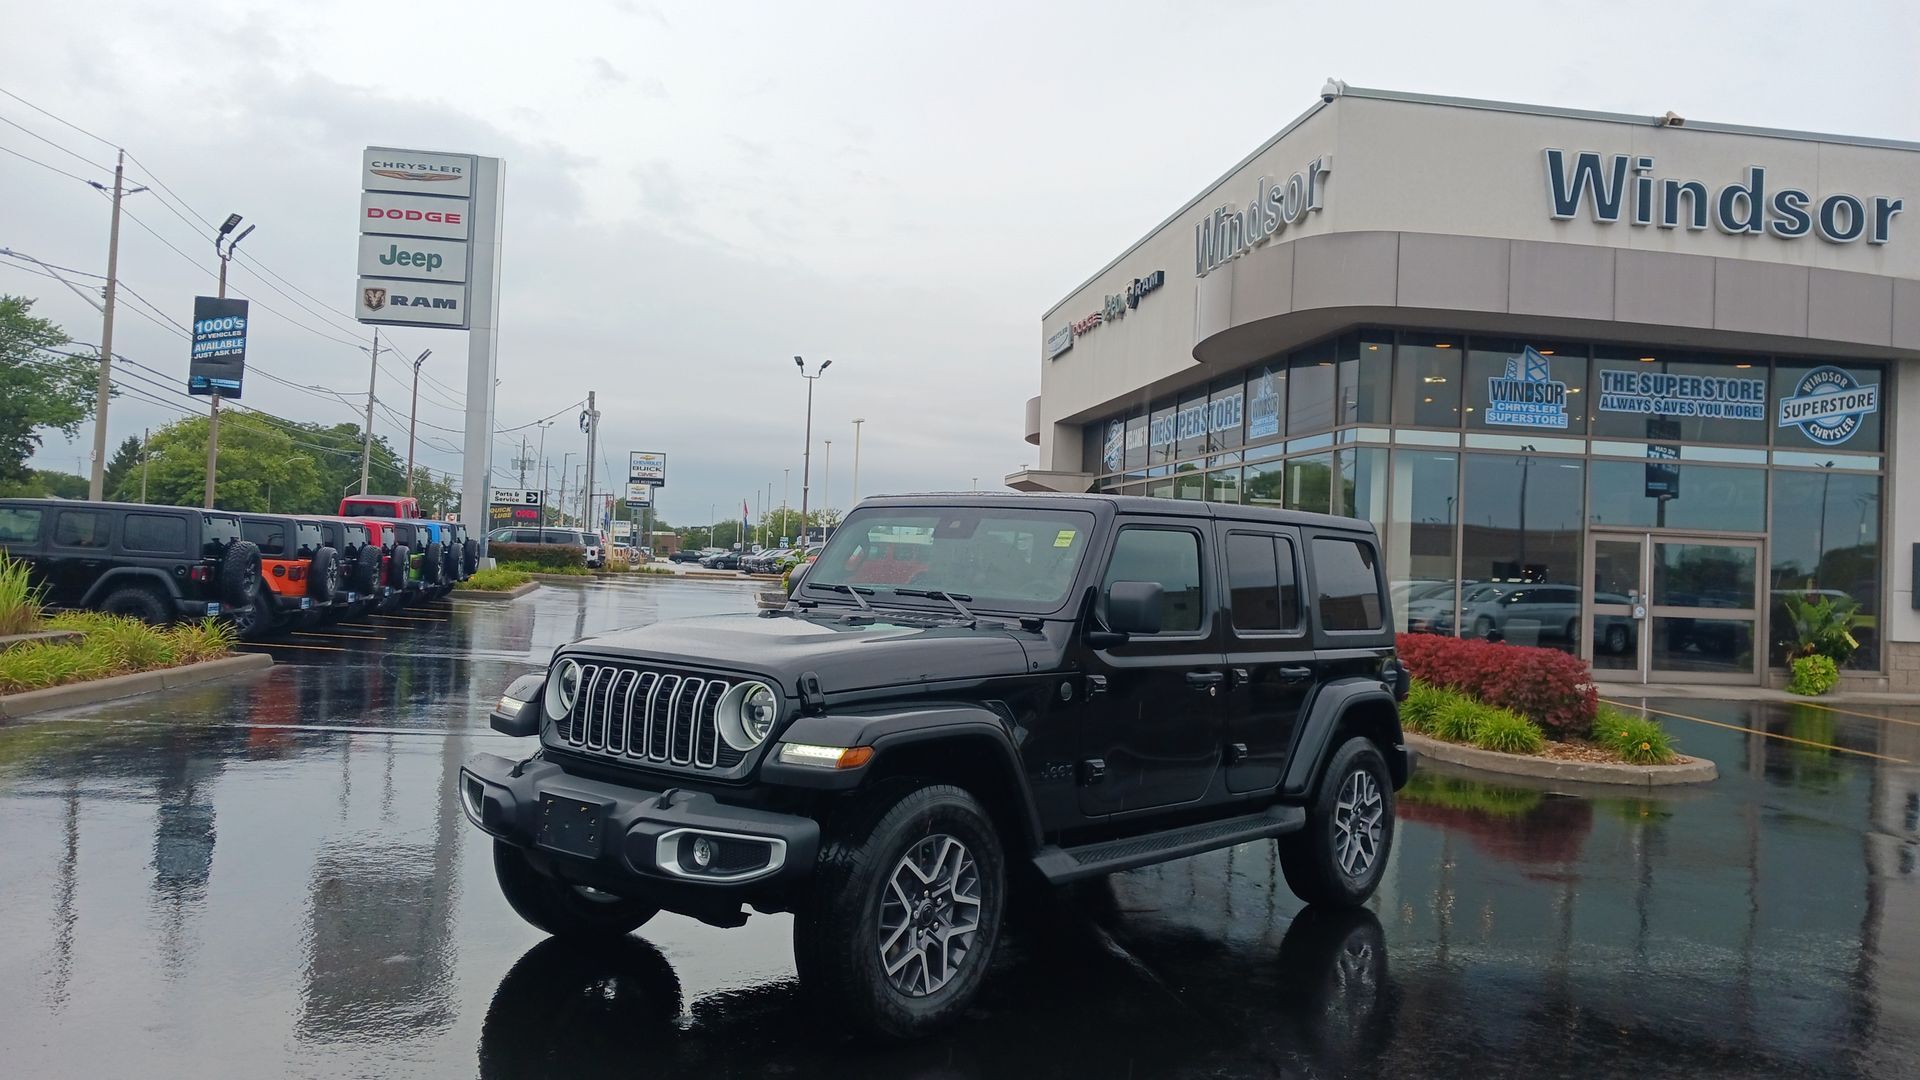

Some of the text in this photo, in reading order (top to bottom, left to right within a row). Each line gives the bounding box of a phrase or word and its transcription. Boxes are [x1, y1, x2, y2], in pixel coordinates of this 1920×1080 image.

[371, 160, 462, 174] CHRYSLER
[1545, 147, 1905, 246] Windsor
[367, 207, 461, 225] DODGE
[1195, 155, 1332, 278] Windsor
[379, 244, 443, 272] Jeep
[1135, 270, 1165, 298] RAM
[390, 295, 457, 310] RAM
[195, 316, 245, 333] 1000's
[208, 329, 242, 339] VEHICLES
[193, 347, 243, 360] JUST ASK US
[194, 339, 244, 353] AVAILABLE
[1601, 371, 1765, 402] THE SUPERSTORE
[1802, 372, 1848, 392] WINDSOR
[1490, 380, 1565, 405] WINDSOR
[1497, 402, 1557, 414] CHRYSLER
[1601, 396, 1764, 419] ALWAYS SAVES YOU MORE!
[1783, 392, 1875, 419] SUPERSTORE
[1151, 421, 1164, 445] THE
[1165, 394, 1242, 443] SUPERSTORE
[1488, 412, 1566, 425] SUPERSTORE
[1809, 417, 1855, 440] CHRYSLER
[632, 465, 663, 473] BUICK
[515, 509, 537, 519] OPEN
